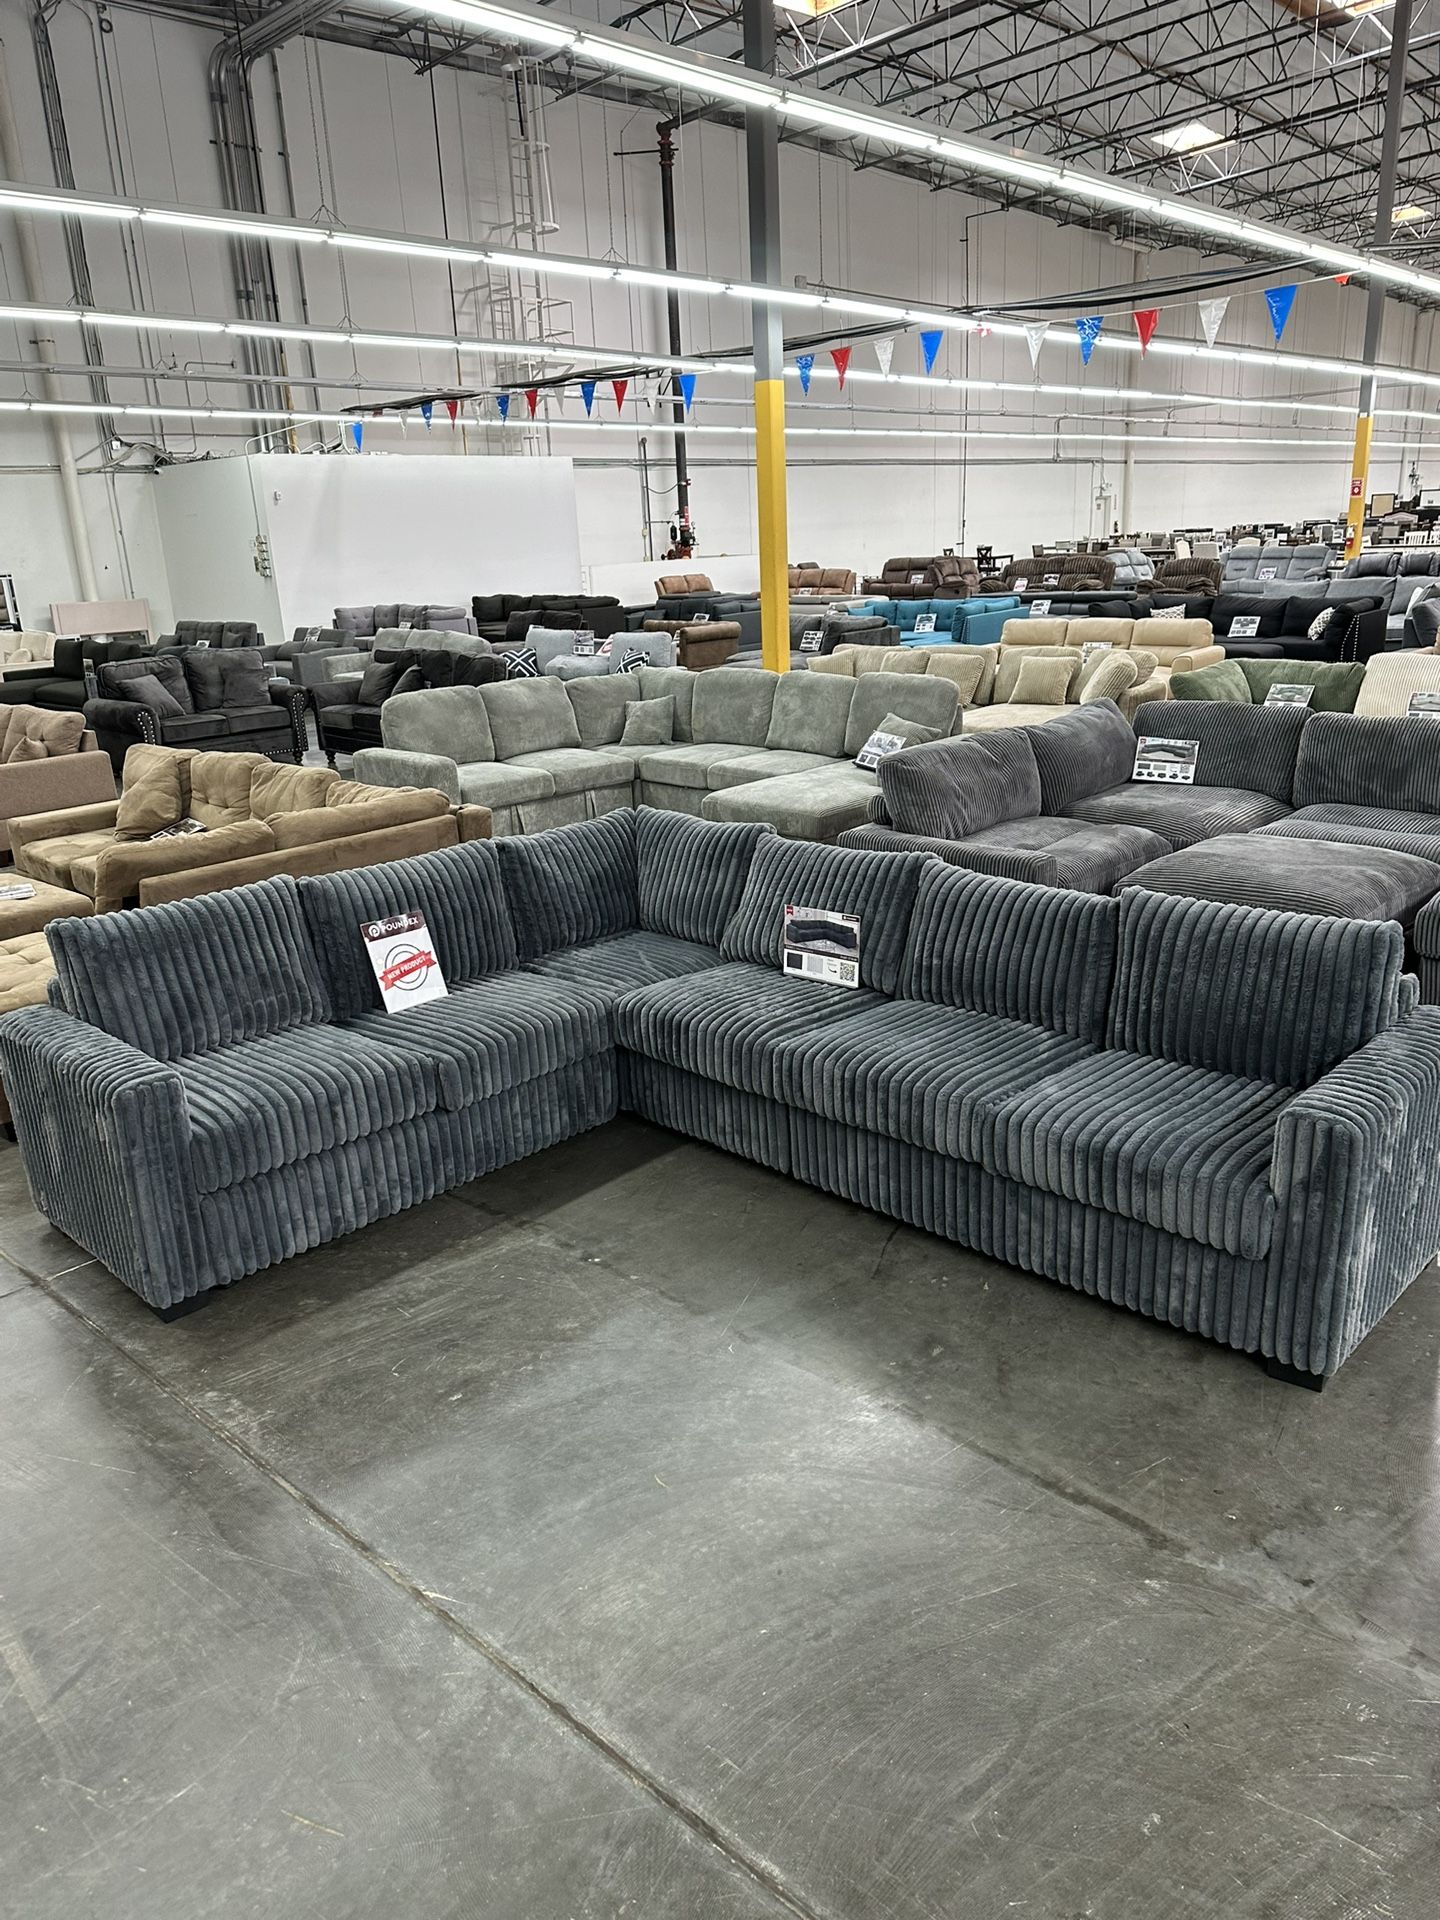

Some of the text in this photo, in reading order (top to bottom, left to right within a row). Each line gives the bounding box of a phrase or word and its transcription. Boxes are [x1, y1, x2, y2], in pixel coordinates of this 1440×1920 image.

[381, 917, 419, 932] POUNDEX
[387, 955, 425, 979] NEW PRODUCT
